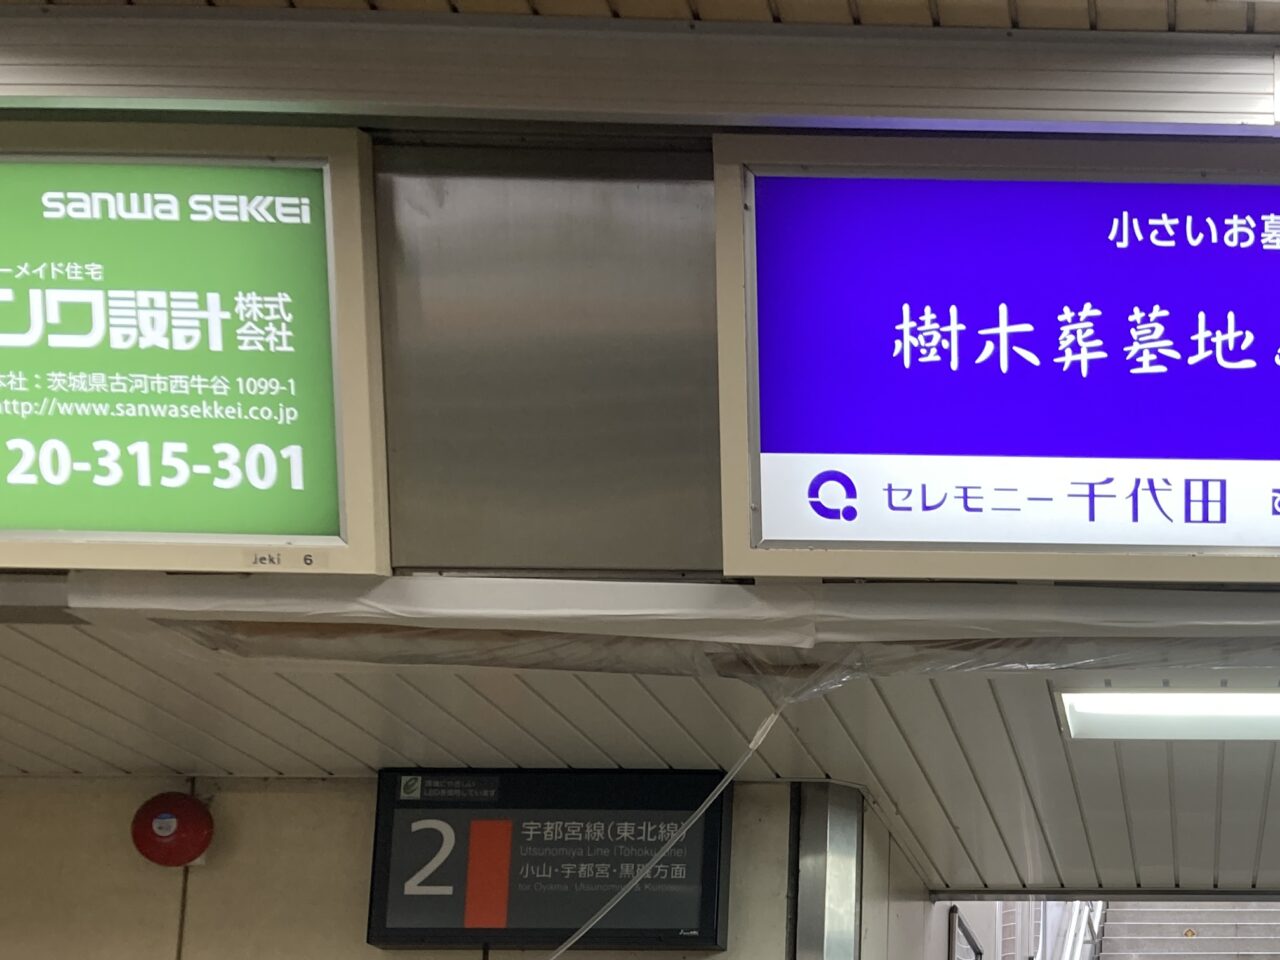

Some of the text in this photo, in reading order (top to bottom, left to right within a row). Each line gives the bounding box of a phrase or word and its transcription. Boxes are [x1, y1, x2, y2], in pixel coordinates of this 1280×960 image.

[234, 291, 293, 323] 株式
[236, 322, 295, 352] 会社
[236, 377, 296, 396] 1099-1
[0, 398, 298, 424] ttp://www.sanwasekkei.co.jp
[6, 438, 304, 490] 20-315-301
[883, 477, 1227, 524] セレモニー千代田
[303, 554, 313, 566] 6
[403, 819, 456, 896] 2
